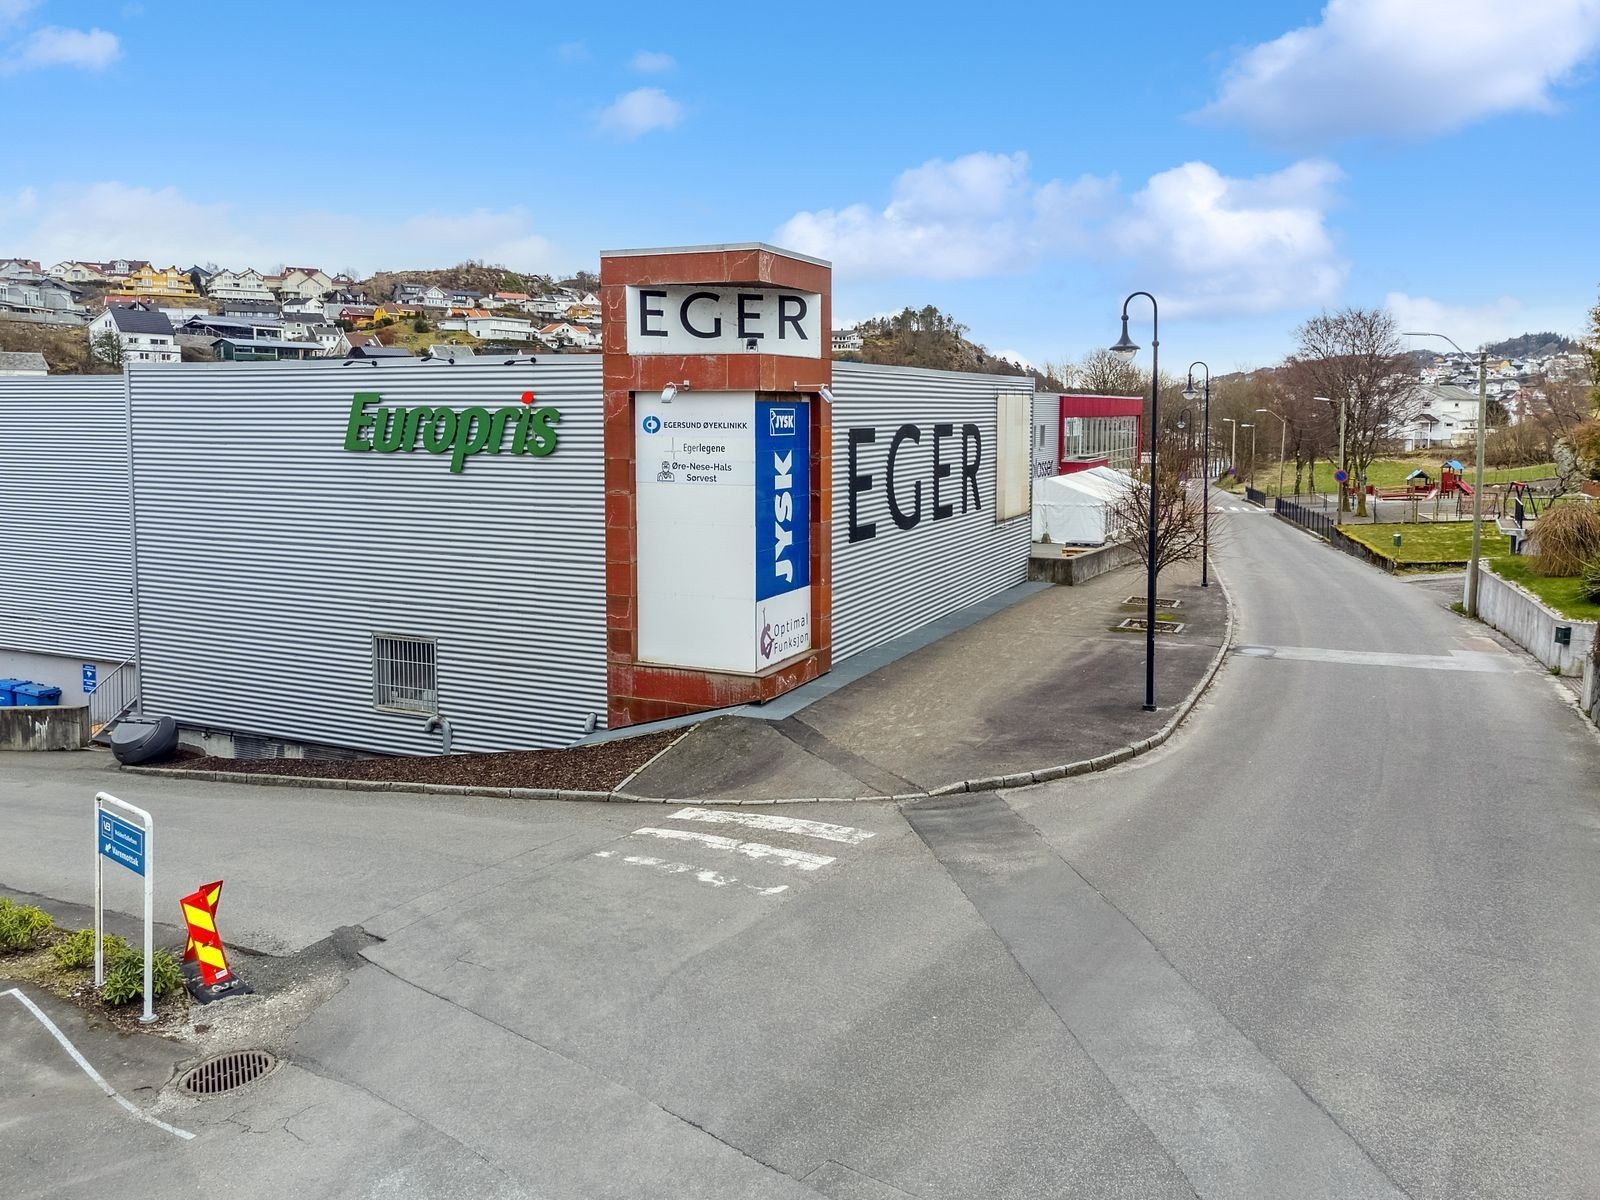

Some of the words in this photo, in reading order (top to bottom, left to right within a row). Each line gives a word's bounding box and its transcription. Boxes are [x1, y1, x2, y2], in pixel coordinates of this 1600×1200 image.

[640, 289, 809, 340] EGER
[344, 391, 561, 474] Europris
[663, 421, 702, 429] EGERSUND
[703, 421, 748, 429] ØYEKLINIKK
[775, 415, 794, 429] JYSK
[683, 443, 726, 454] Egerlegene
[671, 461, 732, 472] Øre-Nese-Hals
[686, 473, 718, 483] Sørvest
[848, 423, 982, 544] EGER
[774, 450, 793, 583] JYSK
[774, 612, 809, 637] Optimal
[774, 632, 809, 655] Funksjon
